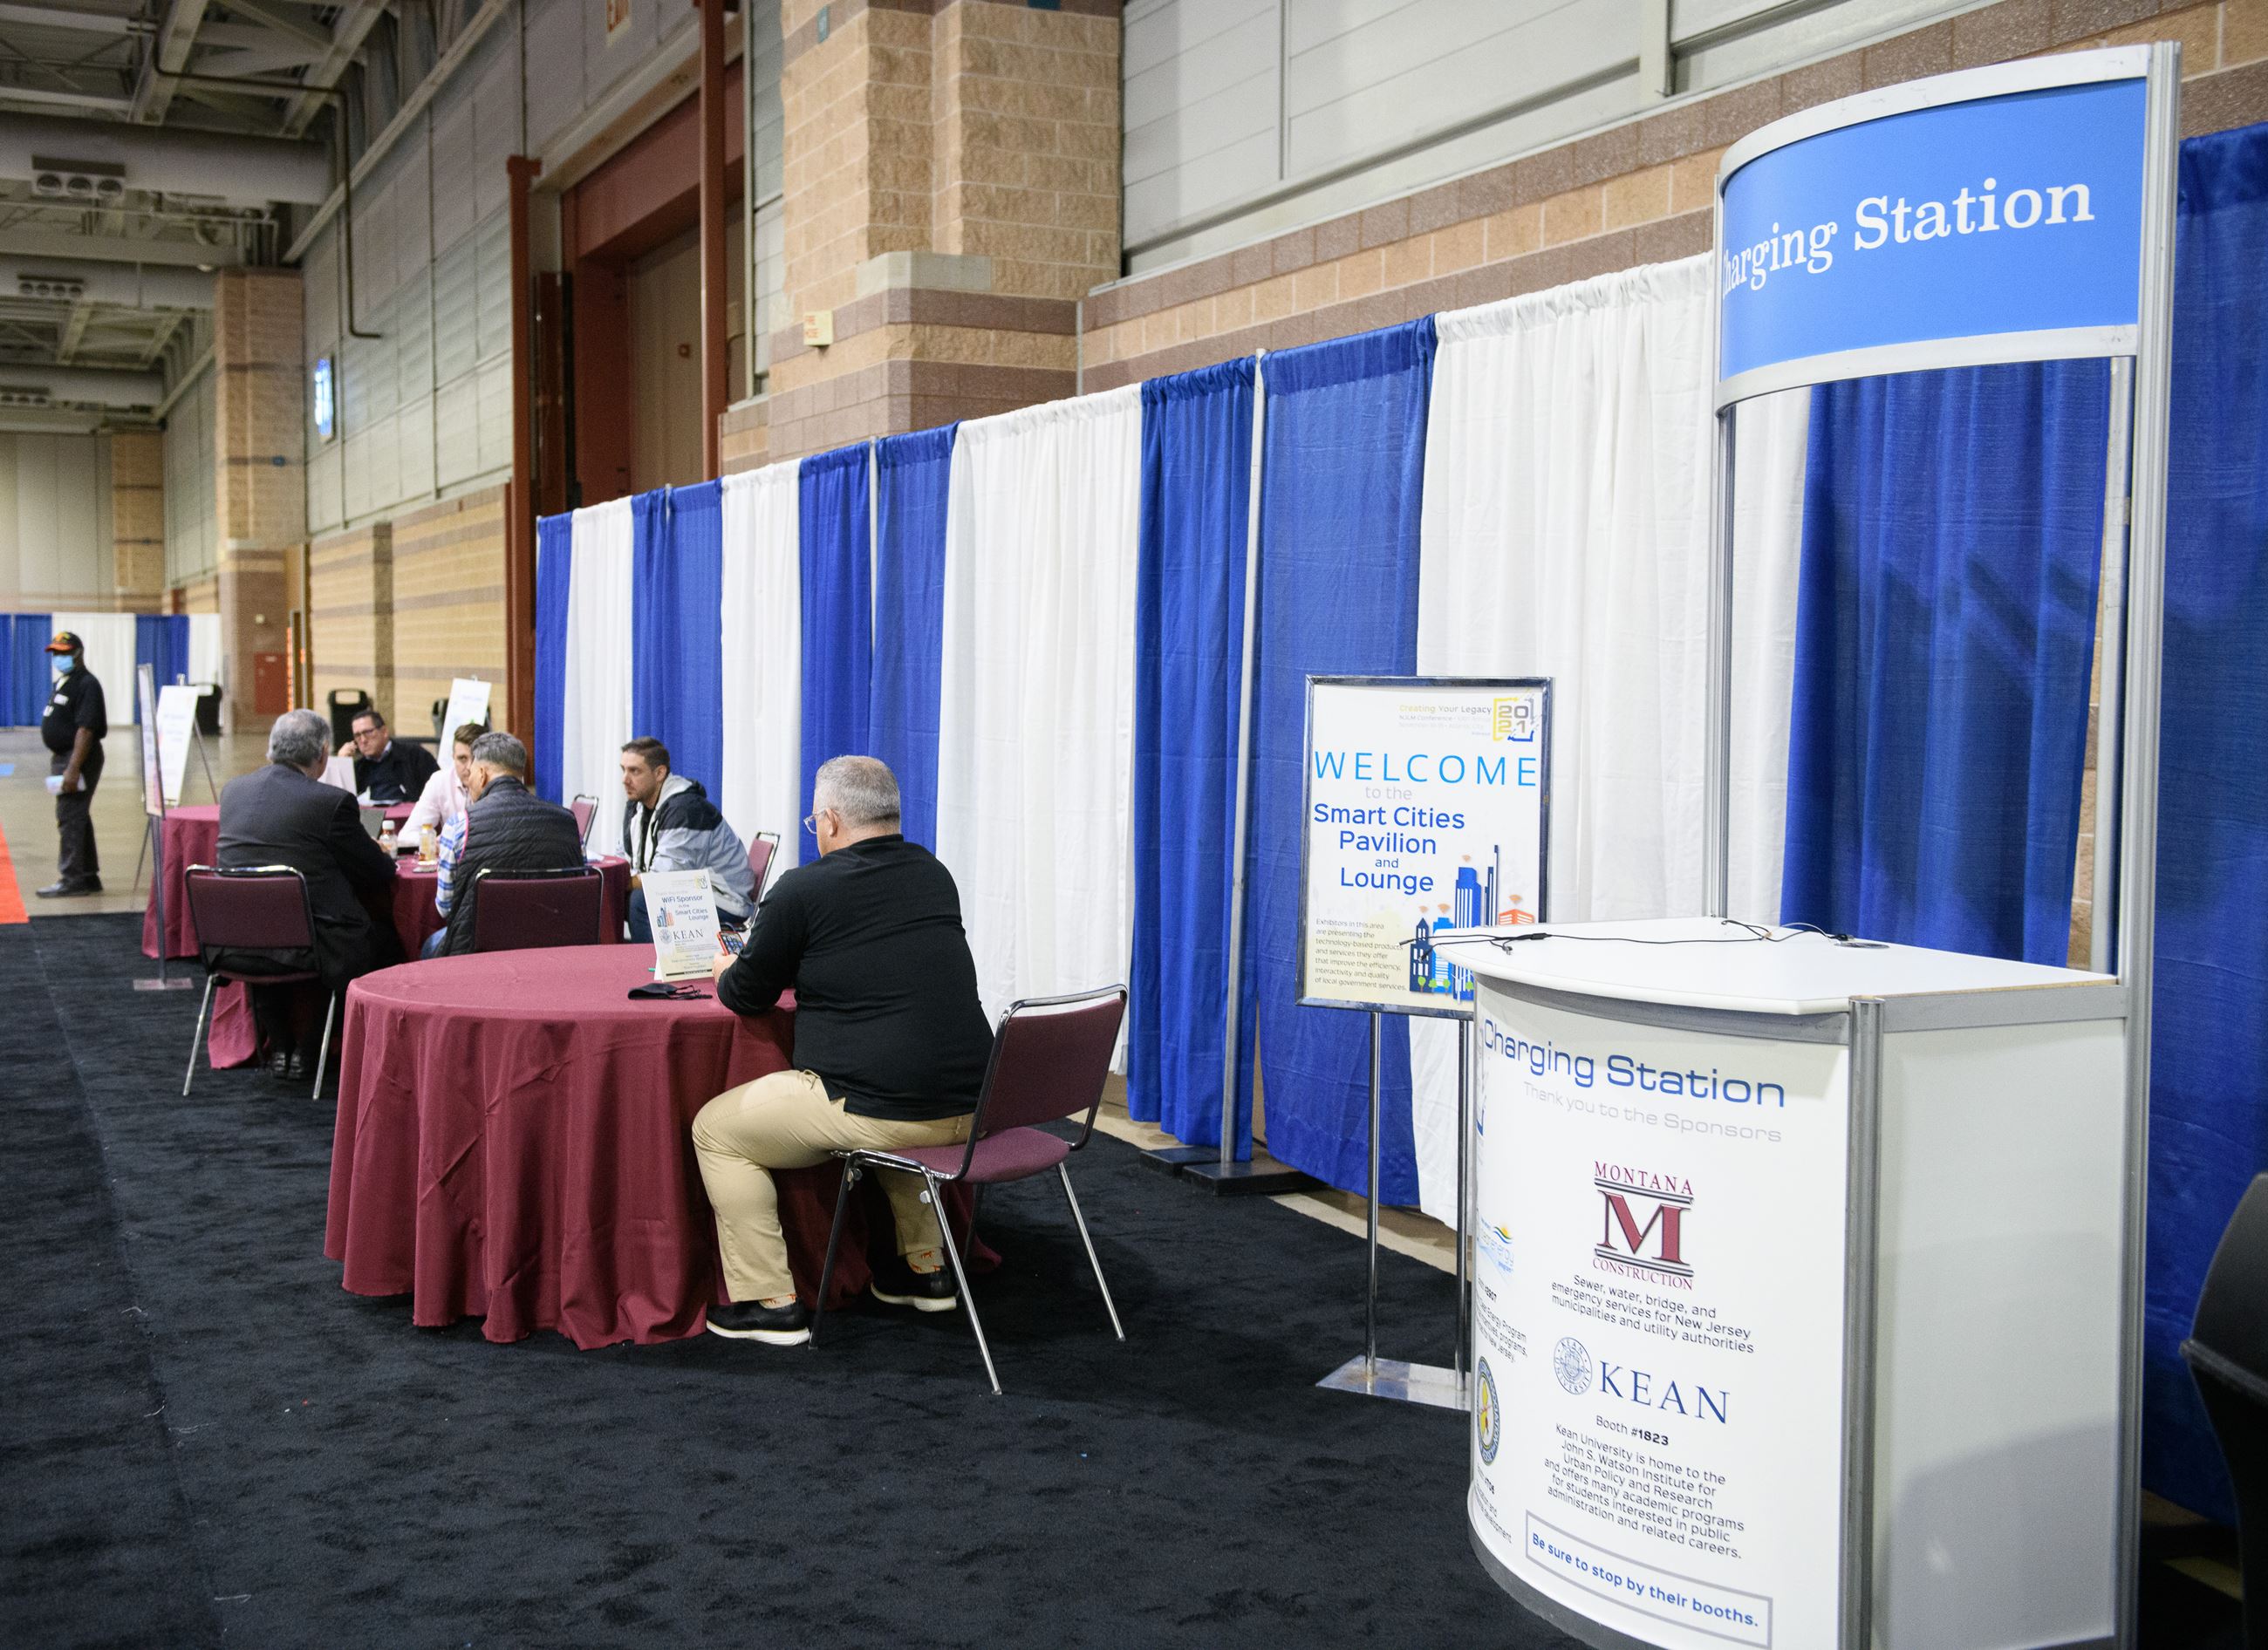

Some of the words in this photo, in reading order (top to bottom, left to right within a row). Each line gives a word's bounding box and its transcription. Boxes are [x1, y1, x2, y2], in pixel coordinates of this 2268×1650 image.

[1722, 220, 1837, 301] harging
[1855, 177, 2095, 251] Station
[1399, 705, 1436, 714] Creating
[1461, 705, 1493, 714] Legacy
[1498, 705, 1529, 719] 20
[1498, 719, 1526, 733] 21
[1315, 751, 1537, 787] WELCOME
[1365, 786, 1381, 799] to
[1386, 787, 1412, 801] the
[1314, 803, 1386, 826] Smart
[1393, 807, 1465, 829] Cities
[1339, 830, 1437, 855] Pavilion
[1375, 858, 1399, 869] and
[1341, 867, 1434, 896] Lounge
[673, 929, 704, 940] KEAN
[1315, 918, 1348, 927] Exhibitors
[1328, 930, 1362, 938] presenting
[1315, 938, 1373, 948] technology-based
[1315, 967, 1353, 977] interactivity
[1338, 979, 1377, 988] government
[1484, 1019, 1595, 1088] Charging
[1607, 1054, 1785, 1108] Station
[1523, 1081, 1564, 1107] Thank
[1565, 1093, 1595, 1114] you
[1600, 1101, 1619, 1118] to
[1623, 1106, 1658, 1125] the
[1663, 1113, 1782, 1143] Sponsors
[1594, 1161, 1694, 1196] MONTANA
[1595, 1190, 1692, 1265] M
[1592, 1257, 1694, 1291] CONSTRUCTION
[1552, 1282, 1602, 1307] emergency
[1605, 1299, 1651, 1319] services
[1655, 1311, 1671, 1323] for
[1675, 1315, 1702, 1330] New
[1706, 1322, 1751, 1340] Jersey
[1574, 1275, 1606, 1294] Sewer,
[1609, 1287, 1642, 1304] water,
[1645, 1294, 1688, 1314] bridge,
[1691, 1306, 1717, 1319] and
[1502, 1319, 1527, 1343] Program
[1552, 1294, 1616, 1323] municipalities
[1619, 1316, 1641, 1330] and
[1643, 1323, 1678, 1340] utility
[1681, 1331, 1754, 1353] authorities
[1599, 1360, 1731, 1425] KEAN
[1595, 1415, 1628, 1435] Booth
[1631, 1428, 1669, 1446] #1823
[1555, 1423, 1578, 1442] Kean
[1581, 1433, 1633, 1462] University
[1636, 1452, 1645, 1465] is
[1649, 1456, 1683, 1475] home
[1686, 1467, 1700, 1479] to
[1704, 1471, 1725, 1485] the
[1561, 1440, 1584, 1456] John
[1587, 1449, 1595, 1462] S.
[1598, 1453, 1639, 1476] Watson
[1642, 1468, 1695, 1492] Institute
[1698, 1483, 1717, 1497] for
[1544, 1458, 1560, 1473] and
[1561, 1467, 1589, 1485] offers
[1591, 1479, 1620, 1498] many
[1622, 1490, 1679, 1516] academic
[1682, 1509, 1745, 1532] programs
[1563, 1452, 1592, 1473] Urban
[1595, 1465, 1625, 1487] Policy
[1629, 1479, 1650, 1494] and
[1653, 1484, 1713, 1510] Research
[1547, 1485, 1615, 1522] administration
[1617, 1516, 1638, 1531] and
[1642, 1524, 1684, 1544] related
[1689, 1538, 1742, 1559] careers.
[1552, 1474, 1564, 1487] for
[1566, 1482, 1610, 1507] students
[1612, 1498, 1672, 1527] interested
[1676, 1518, 1687, 1531] in
[1691, 1524, 1731, 1543] public
[1532, 1532, 1547, 1551] Be
[1547, 1543, 1573, 1565] sure
[1575, 1556, 1588, 1572] to
[1592, 1564, 1623, 1588] stop
[1626, 1576, 1646, 1597] by
[1649, 1585, 1688, 1608] their
[1692, 1592, 1759, 1628] booths.
